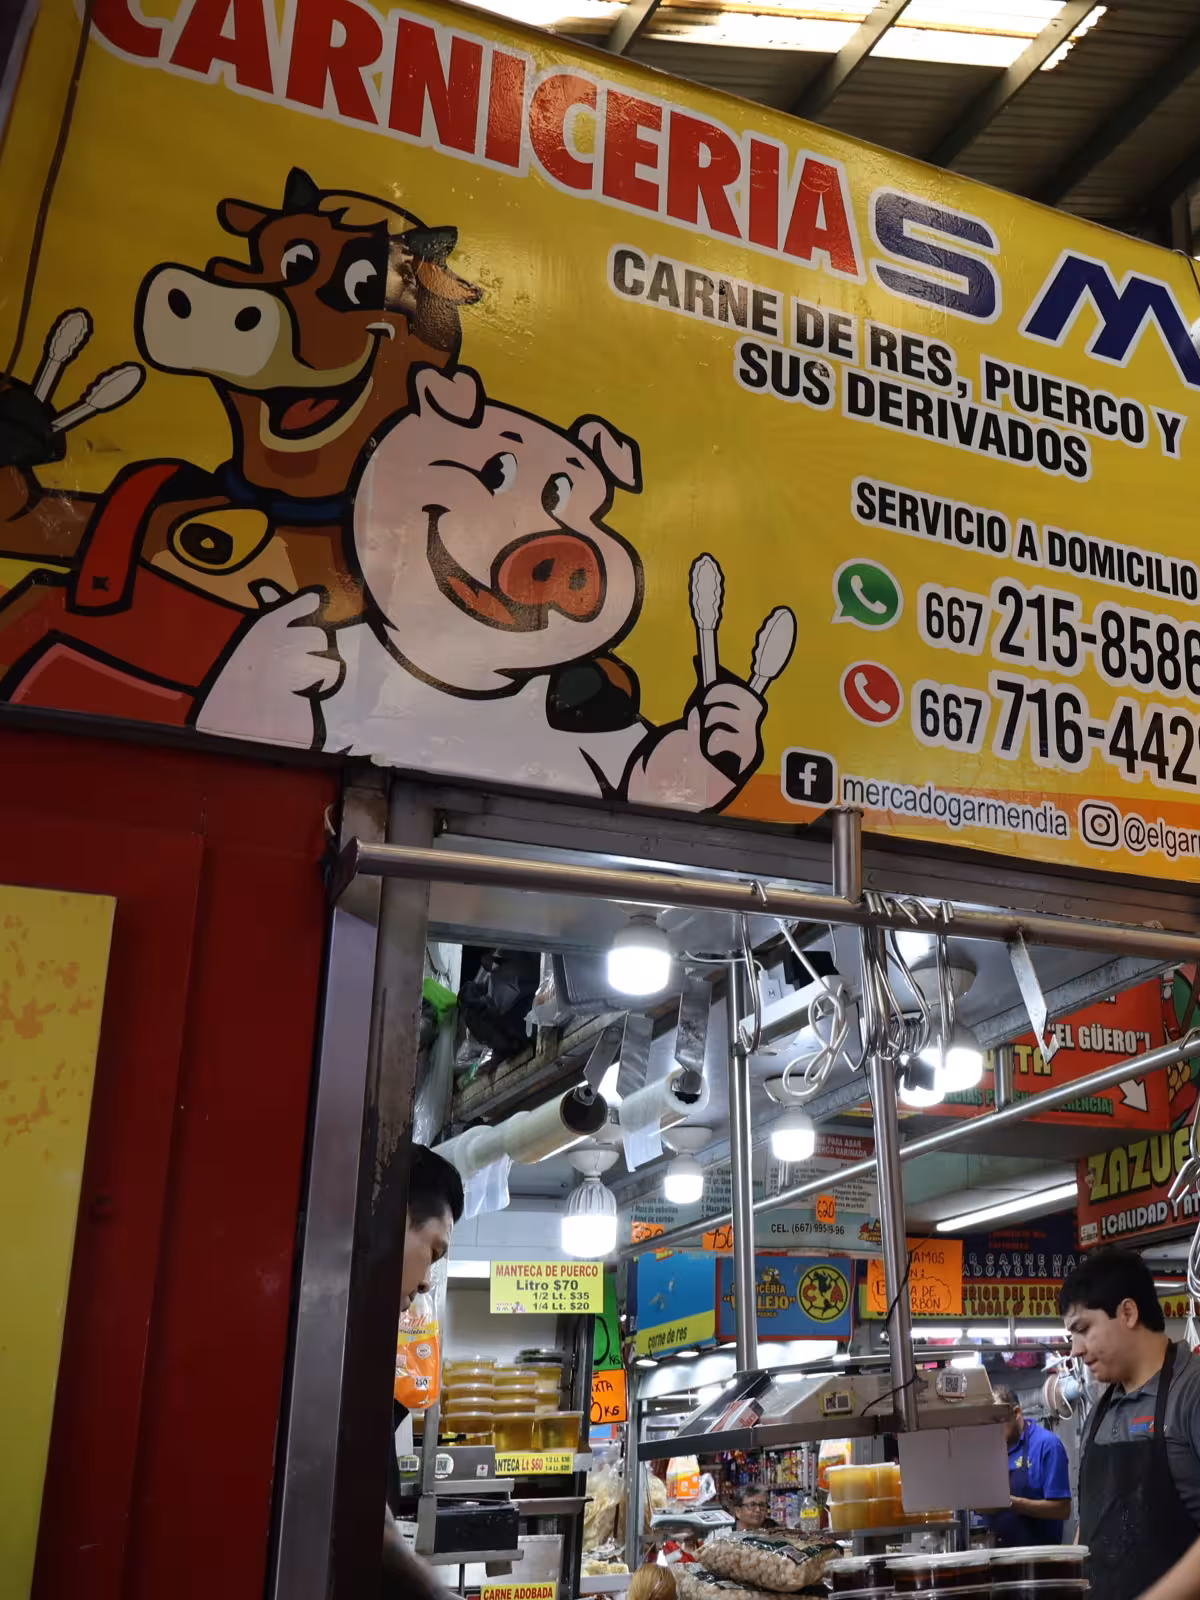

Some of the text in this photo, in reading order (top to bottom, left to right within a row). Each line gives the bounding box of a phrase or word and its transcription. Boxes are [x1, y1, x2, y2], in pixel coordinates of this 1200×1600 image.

[88, 0, 860, 277] CARNICERIA
[613, 249, 1186, 453] CARNE DE RES, PUERCO Y
[739, 342, 1090, 478] SUS DERIVADOS
[855, 482, 1199, 600] SERVICIO A DOMICILIO
[925, 591, 985, 647] 667
[919, 688, 983, 745] 667
[842, 776, 1068, 837] mercadogarmendia
[771, 1223, 812, 1236] CEL. (667)
[496, 1265, 598, 1277] MANTECA DE PUERCO
[517, 1280, 578, 1291] Litro $70
[570, 1292, 590, 1300] $35
[533, 1302, 590, 1310] 1/4 Lt. $20
[676, 1326, 688, 1341] res
[495, 1458, 519, 1472] ANTECA
[483, 1587, 553, 1600] CARNE ADOBADA
